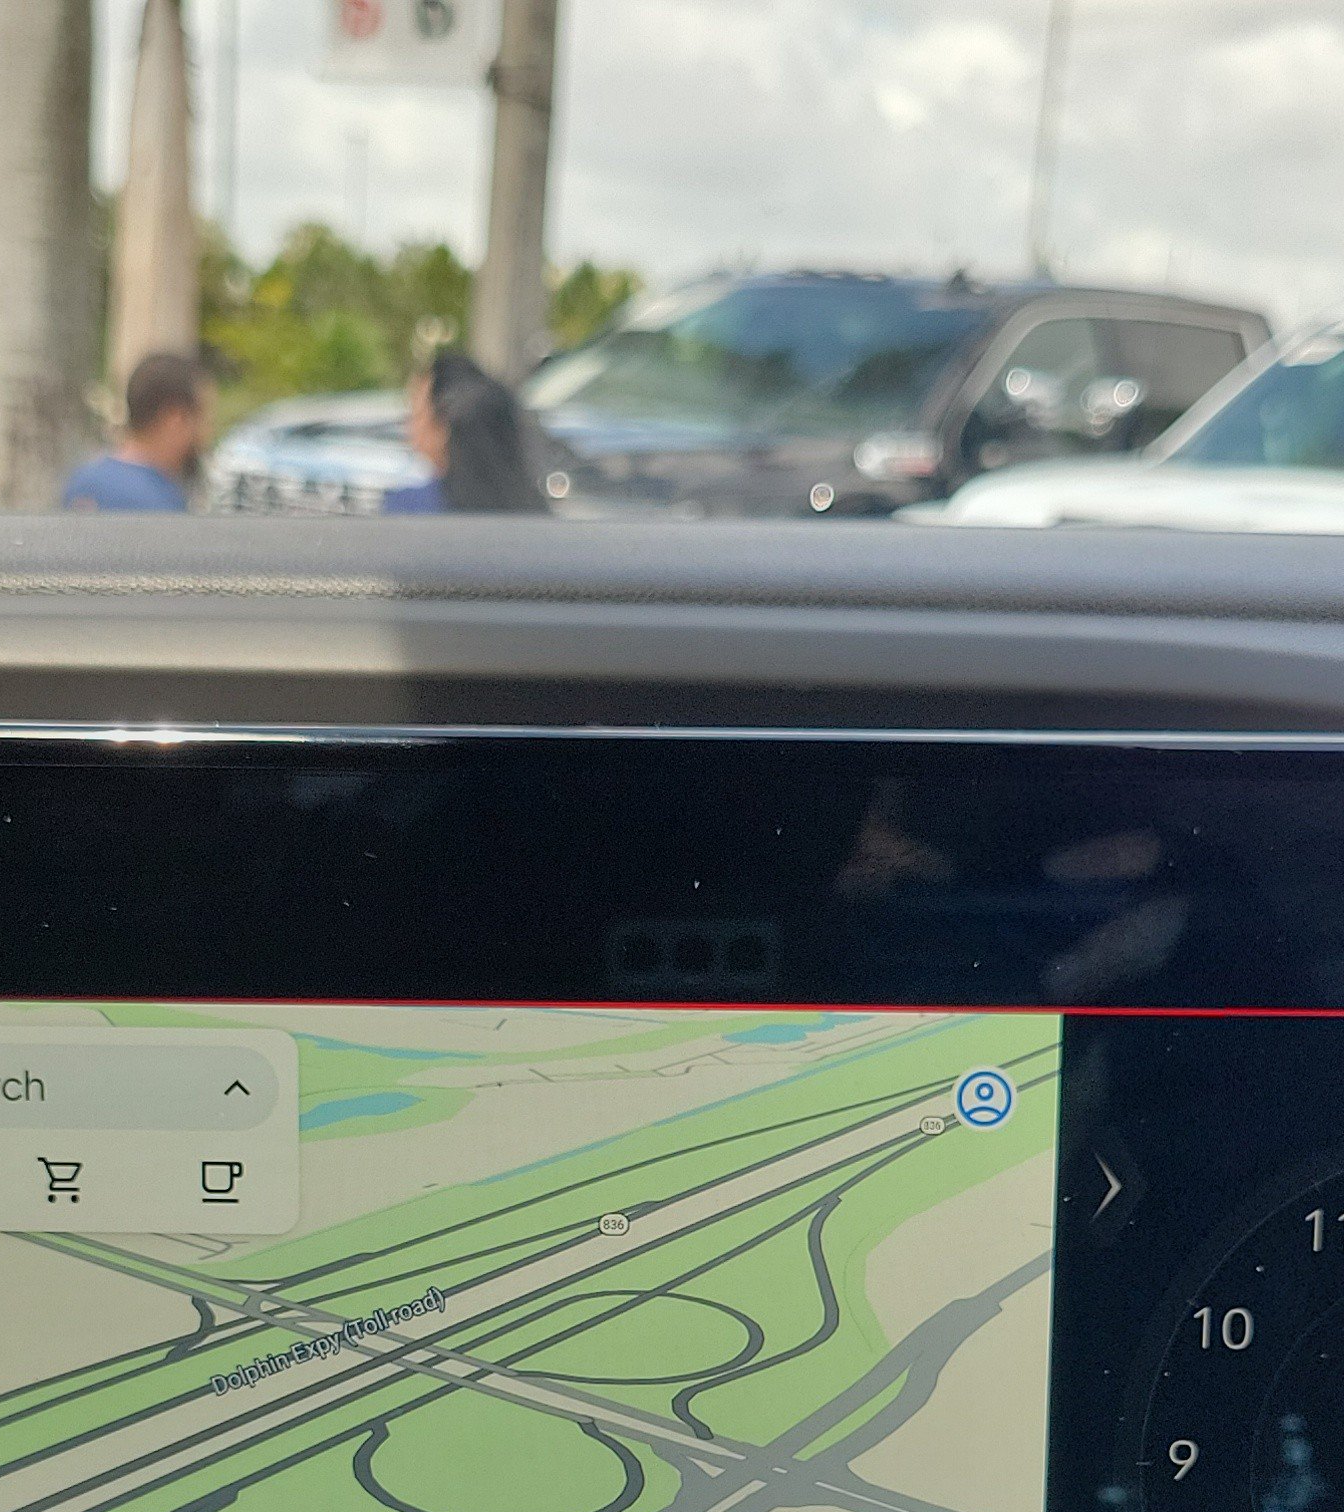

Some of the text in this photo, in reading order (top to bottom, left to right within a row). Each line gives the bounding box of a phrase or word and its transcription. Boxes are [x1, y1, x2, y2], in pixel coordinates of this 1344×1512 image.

[602, 1219, 625, 1231] 836
[211, 1286, 446, 1396] Dolphin Expy (Toll road)
[1193, 1306, 1254, 1350] 10
[1168, 1440, 1199, 1481] 9
